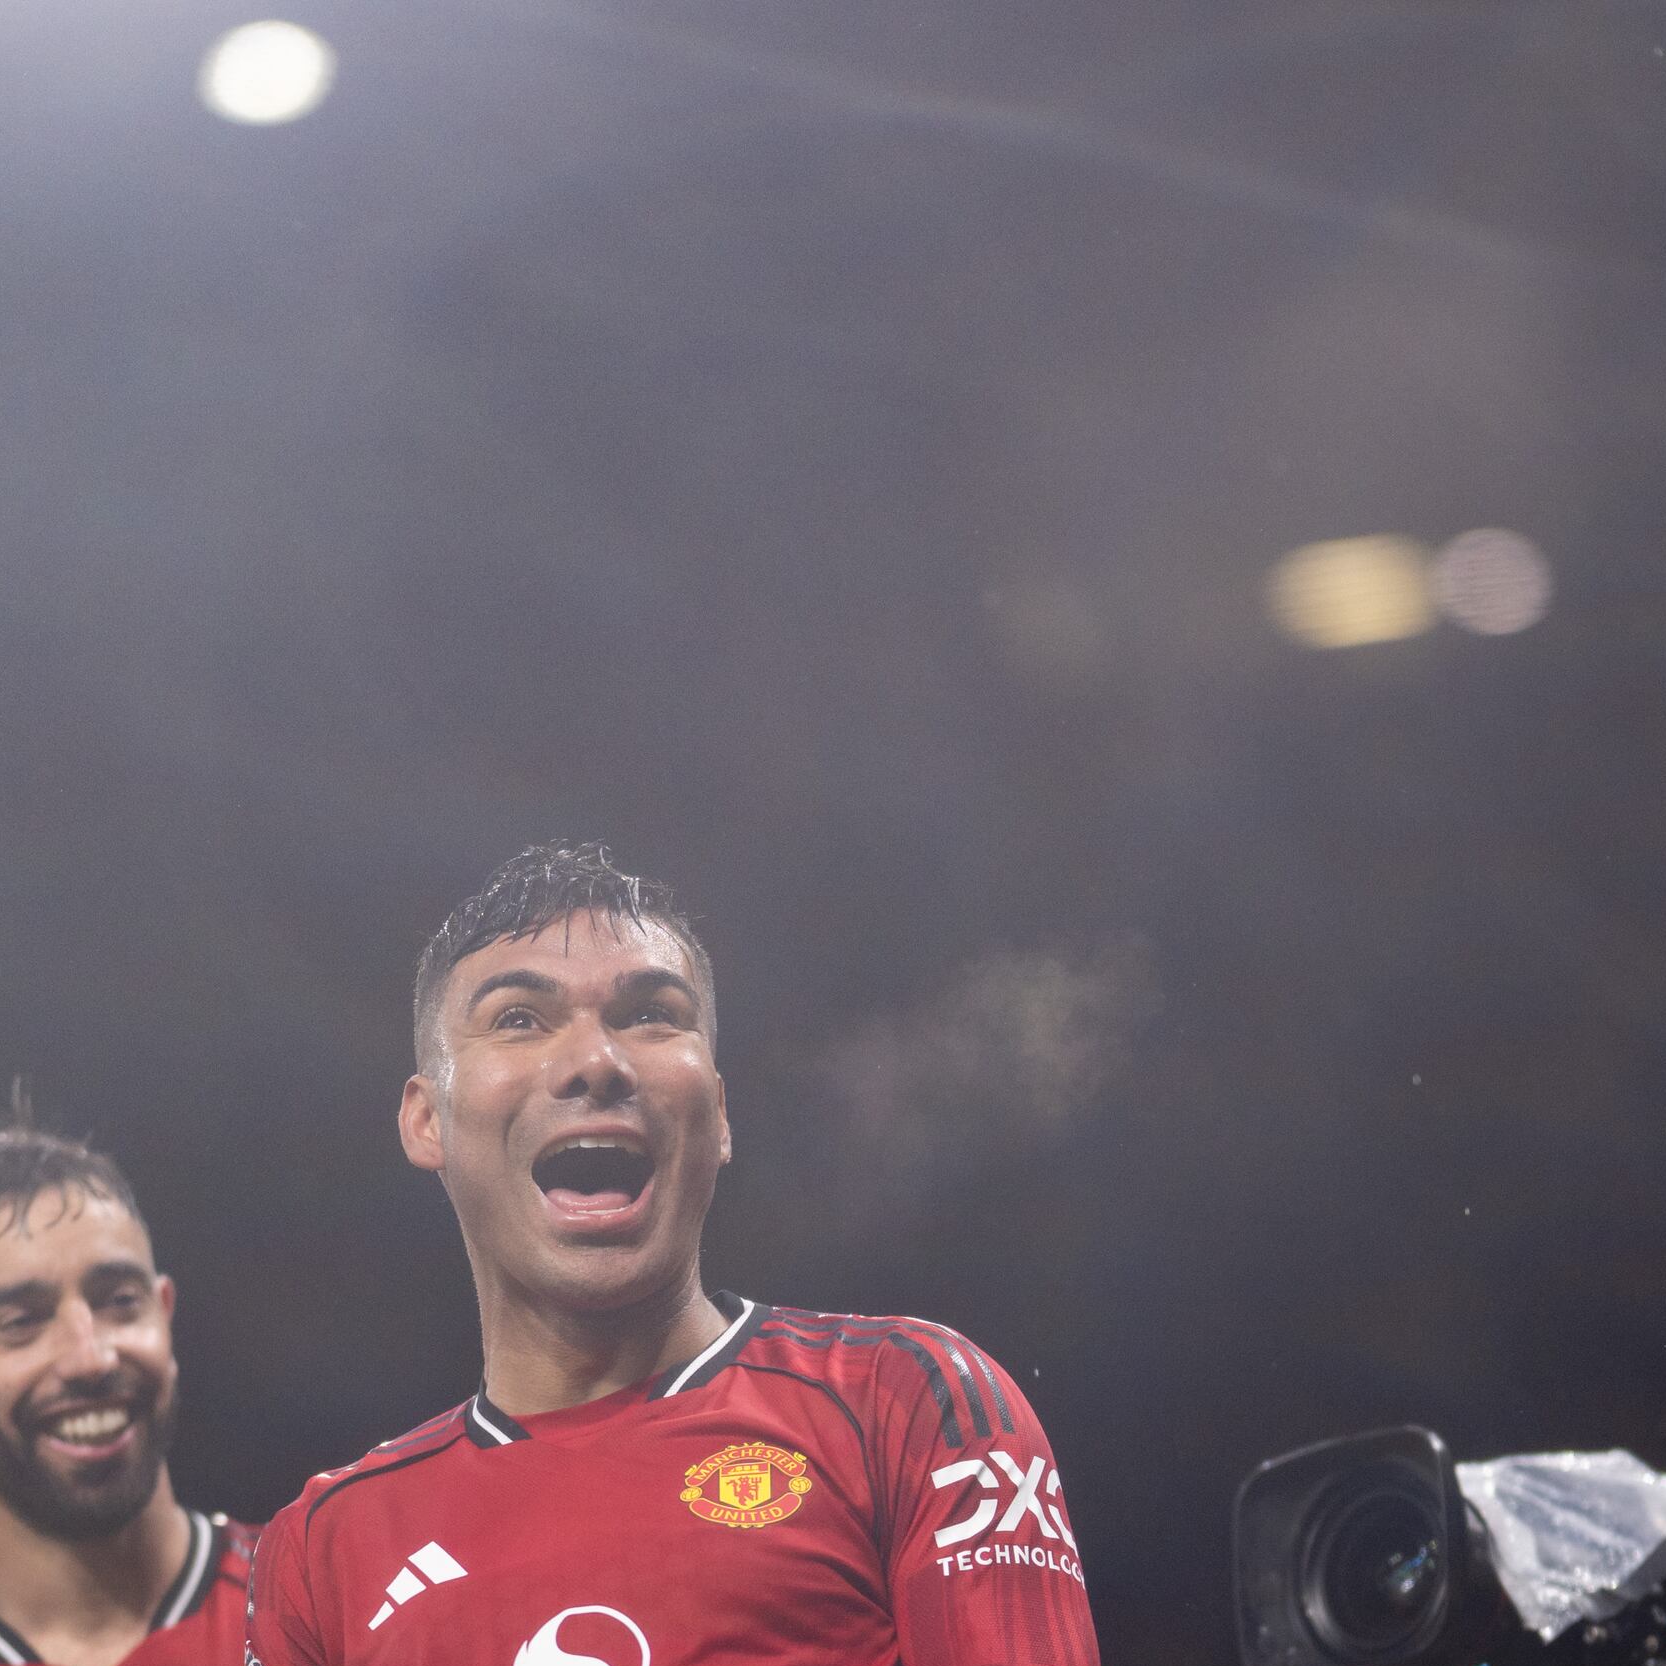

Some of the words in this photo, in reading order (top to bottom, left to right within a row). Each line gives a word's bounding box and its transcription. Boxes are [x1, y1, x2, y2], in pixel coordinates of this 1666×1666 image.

[694, 1448, 798, 1481] MANCHESTER
[709, 1506, 783, 1522] UNITED
[936, 1544, 1085, 1590] TECHNOLOG
